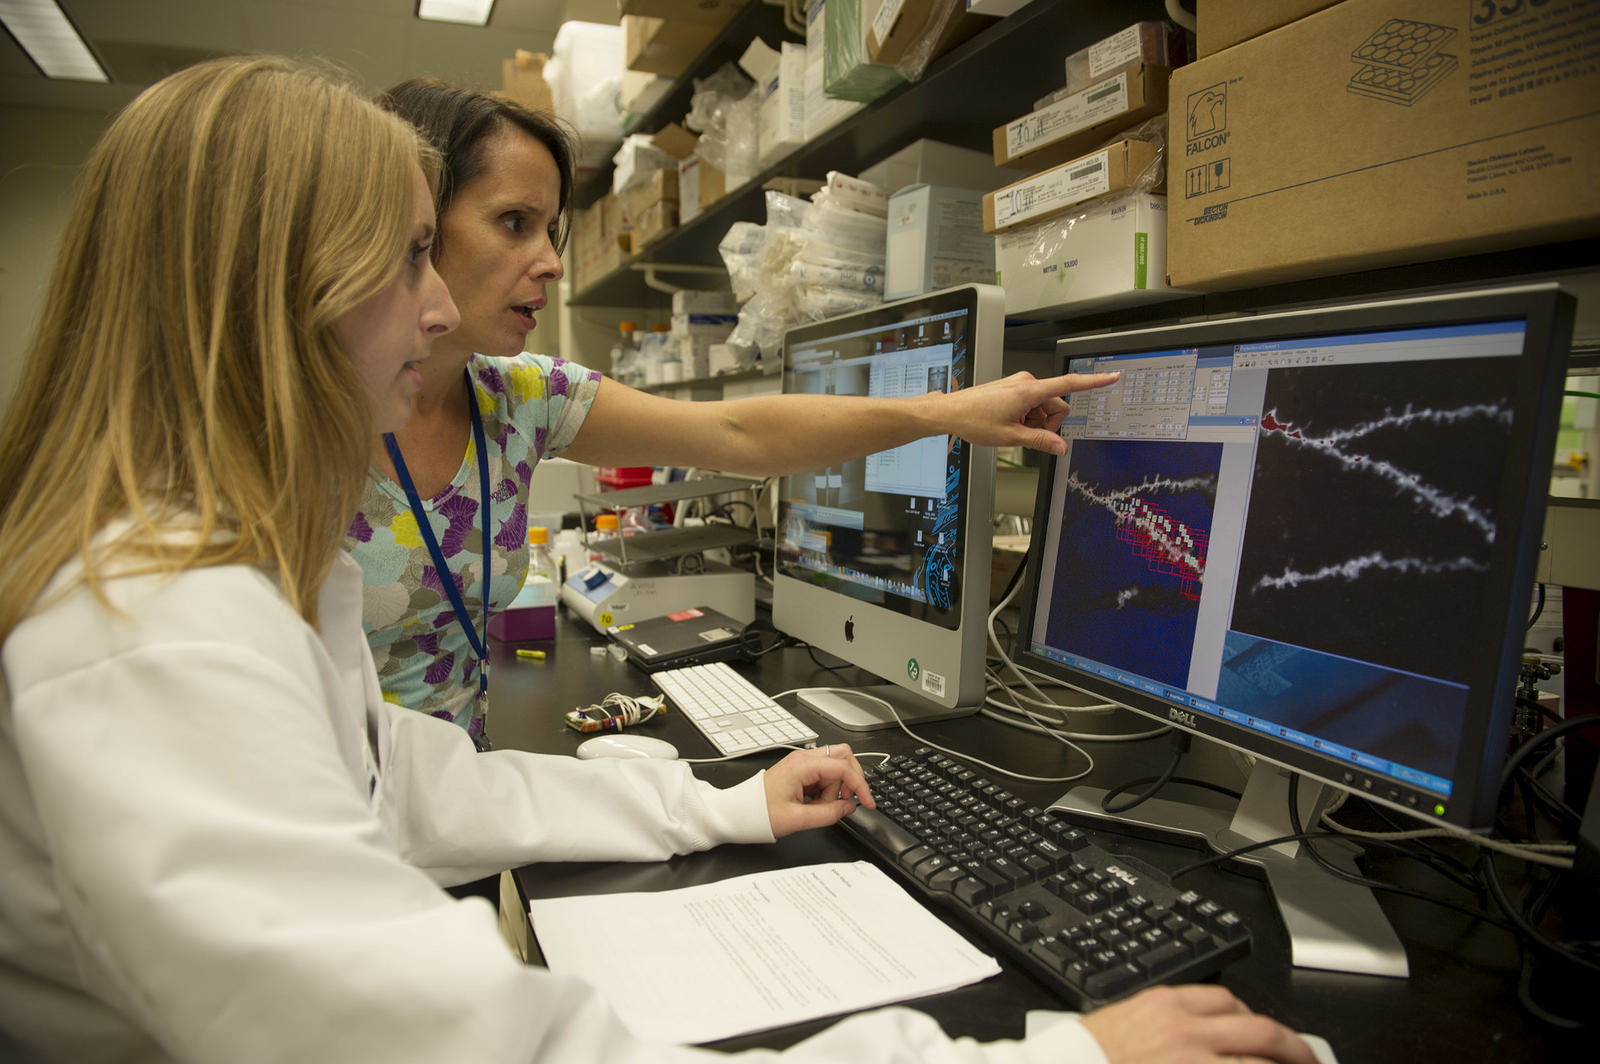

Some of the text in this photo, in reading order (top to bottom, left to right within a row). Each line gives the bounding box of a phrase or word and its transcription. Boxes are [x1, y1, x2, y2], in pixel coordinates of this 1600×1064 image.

[1194, 211, 1227, 225] DICKINSON
[1203, 203, 1228, 216] BECTON
[1169, 707, 1197, 728] DELL
[1106, 865, 1139, 886] DELL
